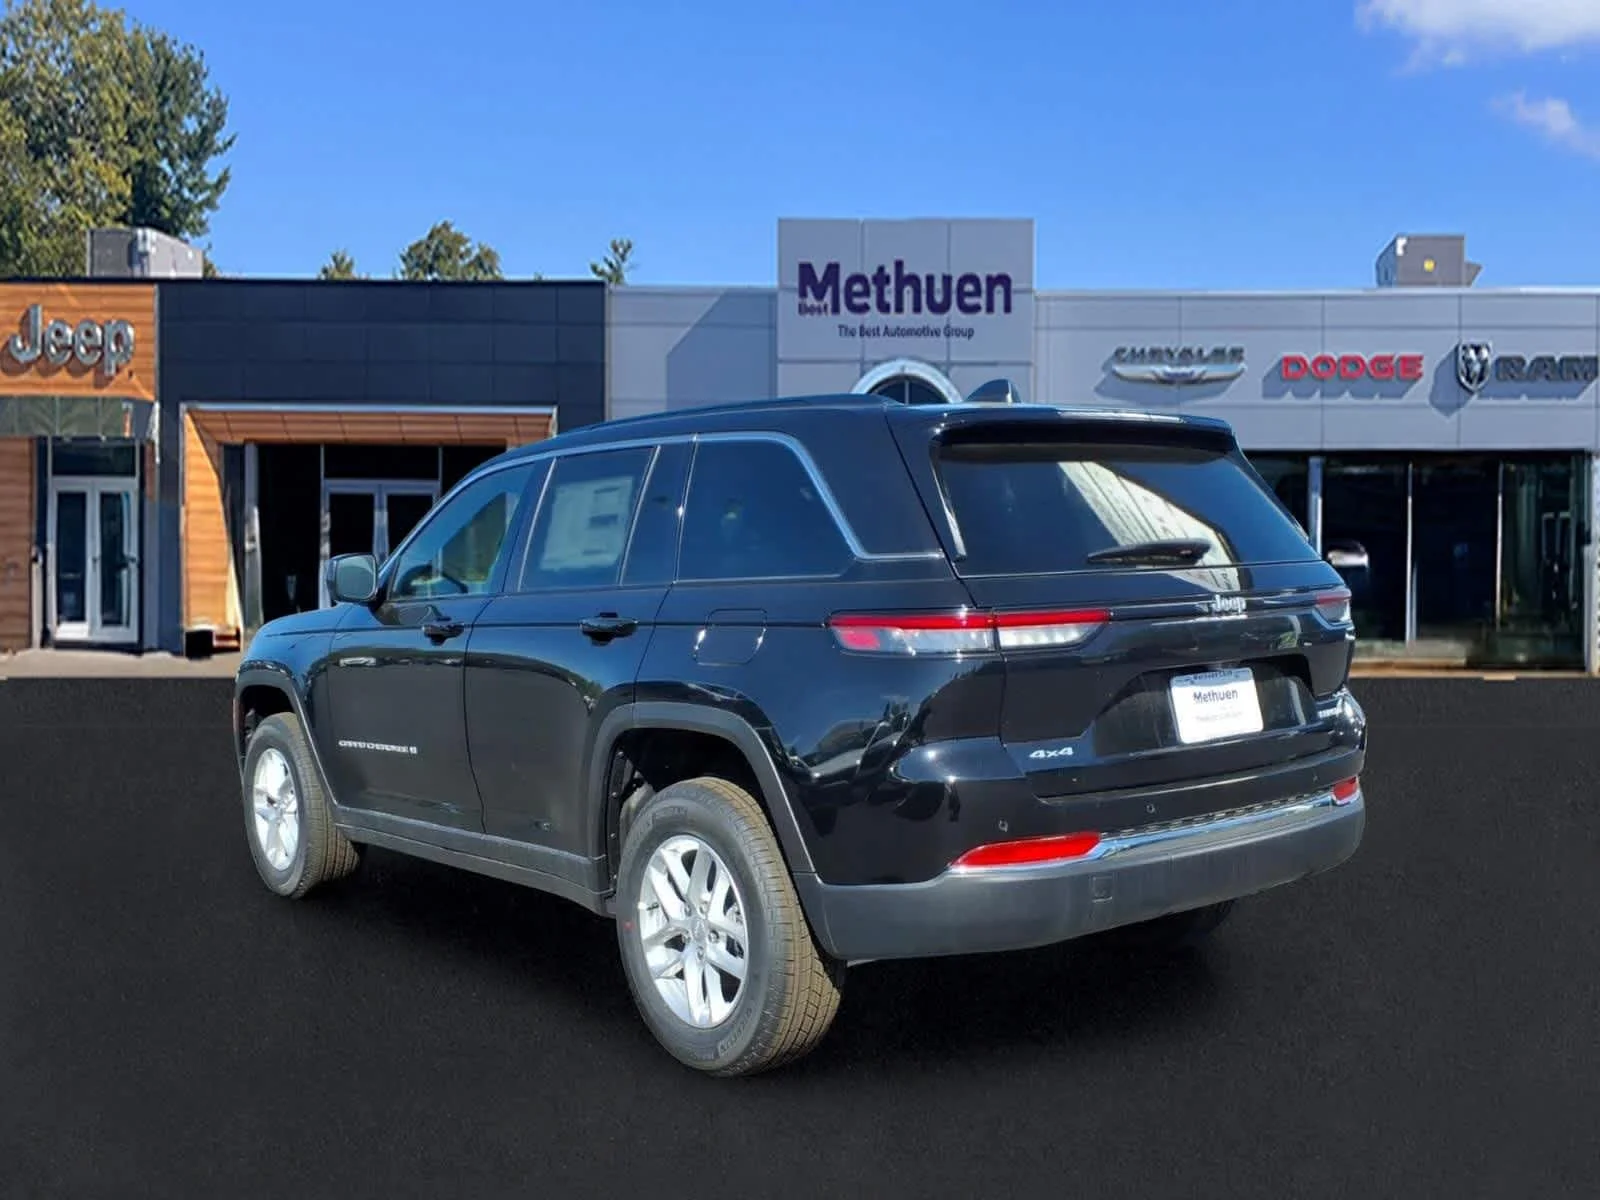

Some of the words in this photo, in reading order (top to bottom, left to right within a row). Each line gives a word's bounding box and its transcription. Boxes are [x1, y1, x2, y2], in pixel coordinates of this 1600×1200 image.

[798, 259, 1012, 315] Methuen
[8, 303, 135, 377] Jeep
[838, 325, 857, 338] The
[859, 325, 881, 338] Best
[883, 325, 941, 338] Automotive
[943, 325, 975, 340] Group
[1112, 345, 1245, 363] CHRYSLER
[1281, 354, 1425, 381] DODGE
[1494, 355, 1598, 382] RAM
[1192, 689, 1239, 703] Methuen
[1028, 747, 1074, 759] 4x4
